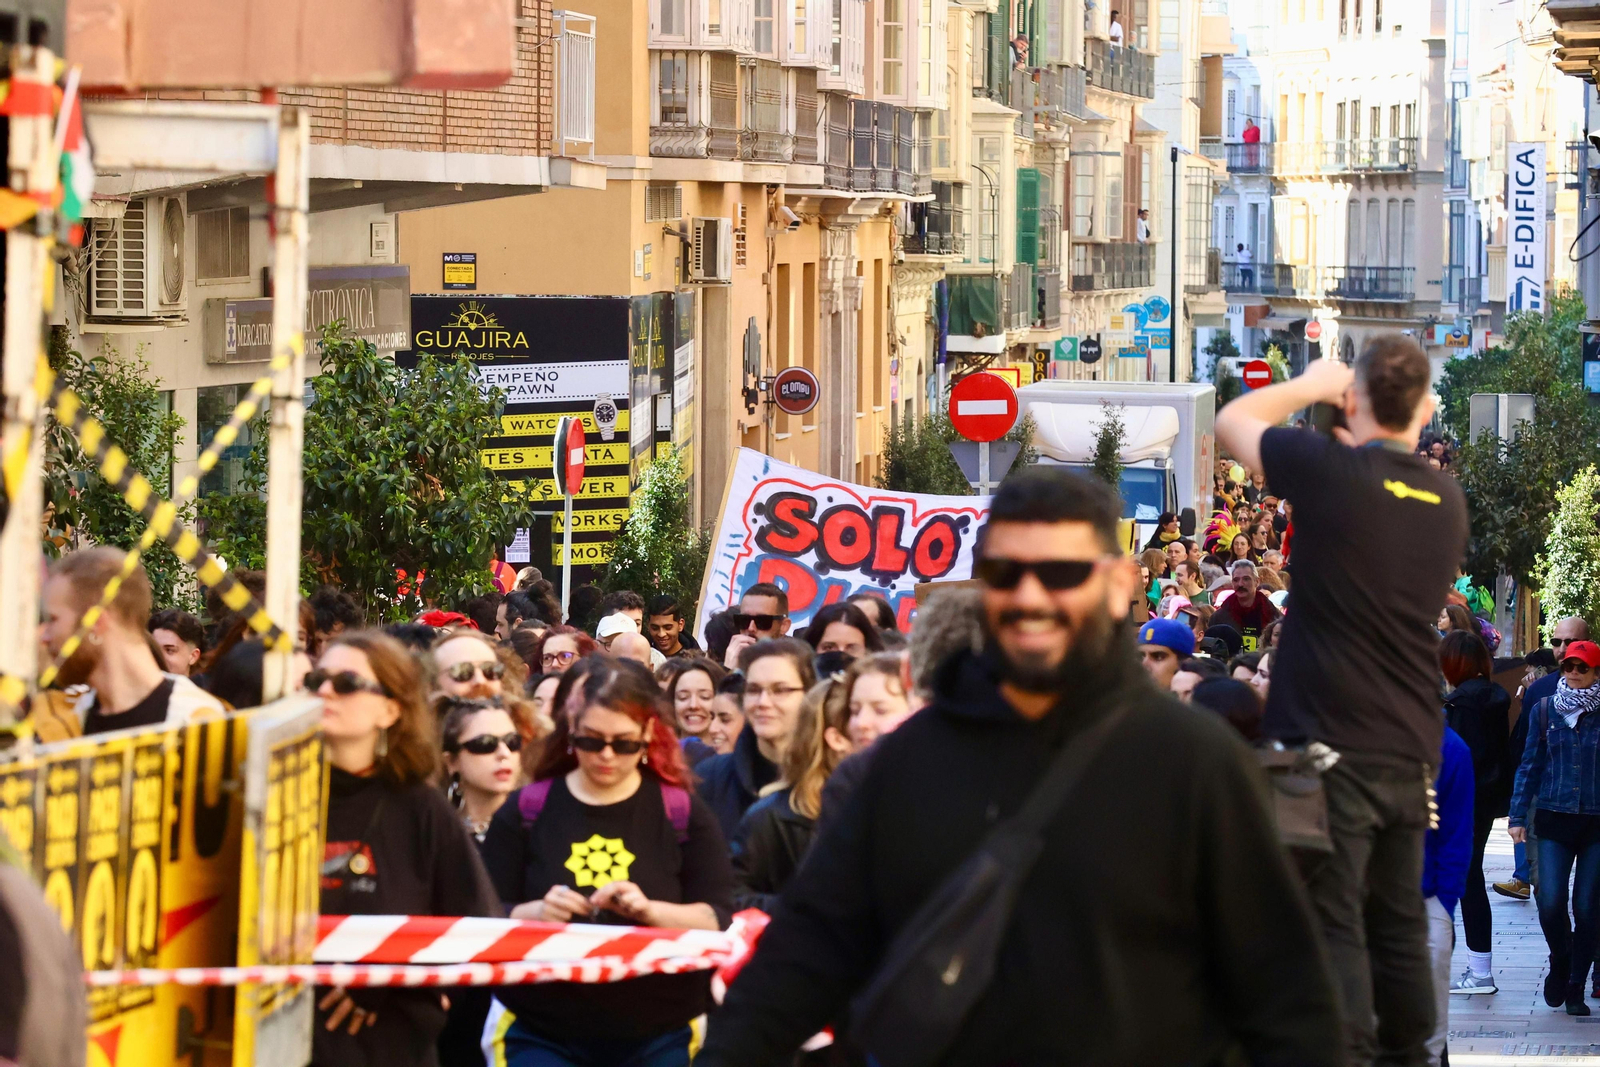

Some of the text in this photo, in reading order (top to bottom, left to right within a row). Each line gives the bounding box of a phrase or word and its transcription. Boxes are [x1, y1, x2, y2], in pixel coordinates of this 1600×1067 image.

[1514, 148, 1536, 269] E-DIFICA
[237, 323, 275, 347] MERCATRO
[415, 330, 530, 349] GUAJIRA
[451, 352, 495, 361] ROJES
[1035, 352, 1046, 382] ORO
[486, 368, 559, 384] EMPEÑO
[508, 384, 555, 395] PAWN
[510, 417, 592, 430] WATCS
[542, 482, 615, 495] SVER
[754, 491, 961, 583] SOLO
